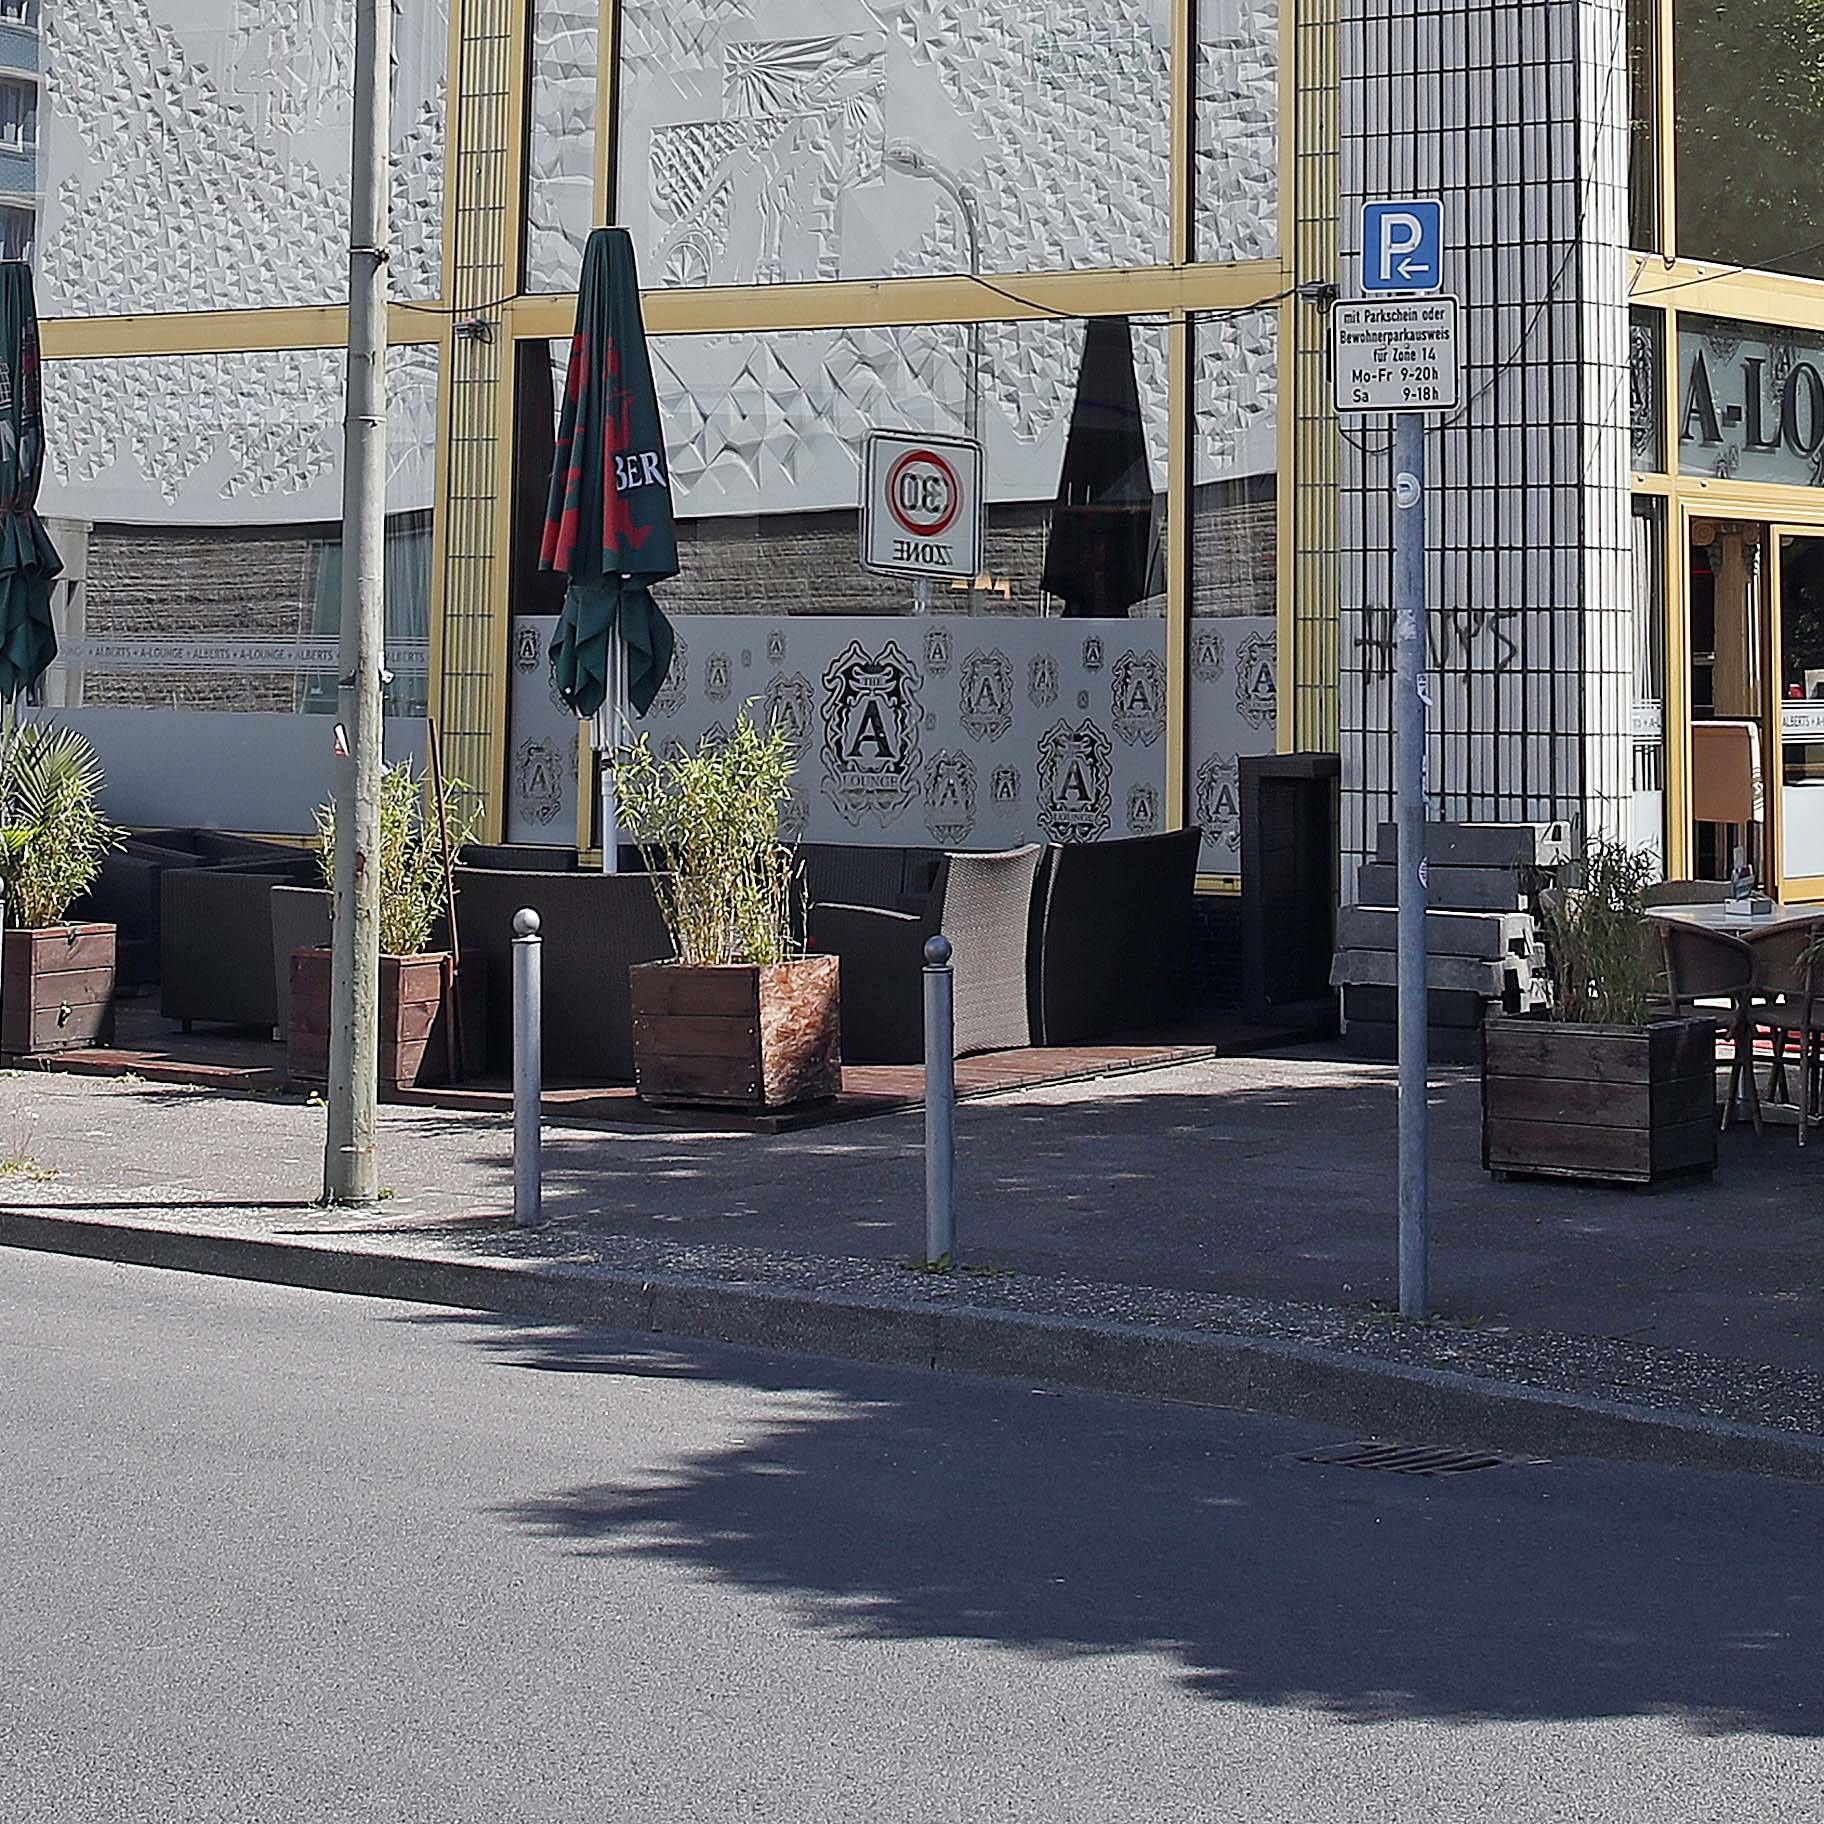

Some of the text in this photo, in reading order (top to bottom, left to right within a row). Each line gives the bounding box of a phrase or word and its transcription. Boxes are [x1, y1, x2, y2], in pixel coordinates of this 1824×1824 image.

[1380, 213, 1422, 280] P
[1344, 307, 1445, 324] mit Parkschein oder
[1339, 326, 1450, 346] Bewohnerparkausweis
[1373, 347, 1436, 363] für Zone 14
[1352, 366, 1439, 383] Mo-Fr 9-20h
[1353, 386, 1439, 403] Sa 9-18h
[192, 648, 230, 660] ALBERTS
[239, 648, 285, 661] A-LOUNGE
[847, 700, 896, 759] A
[1059, 758, 1093, 802] A
